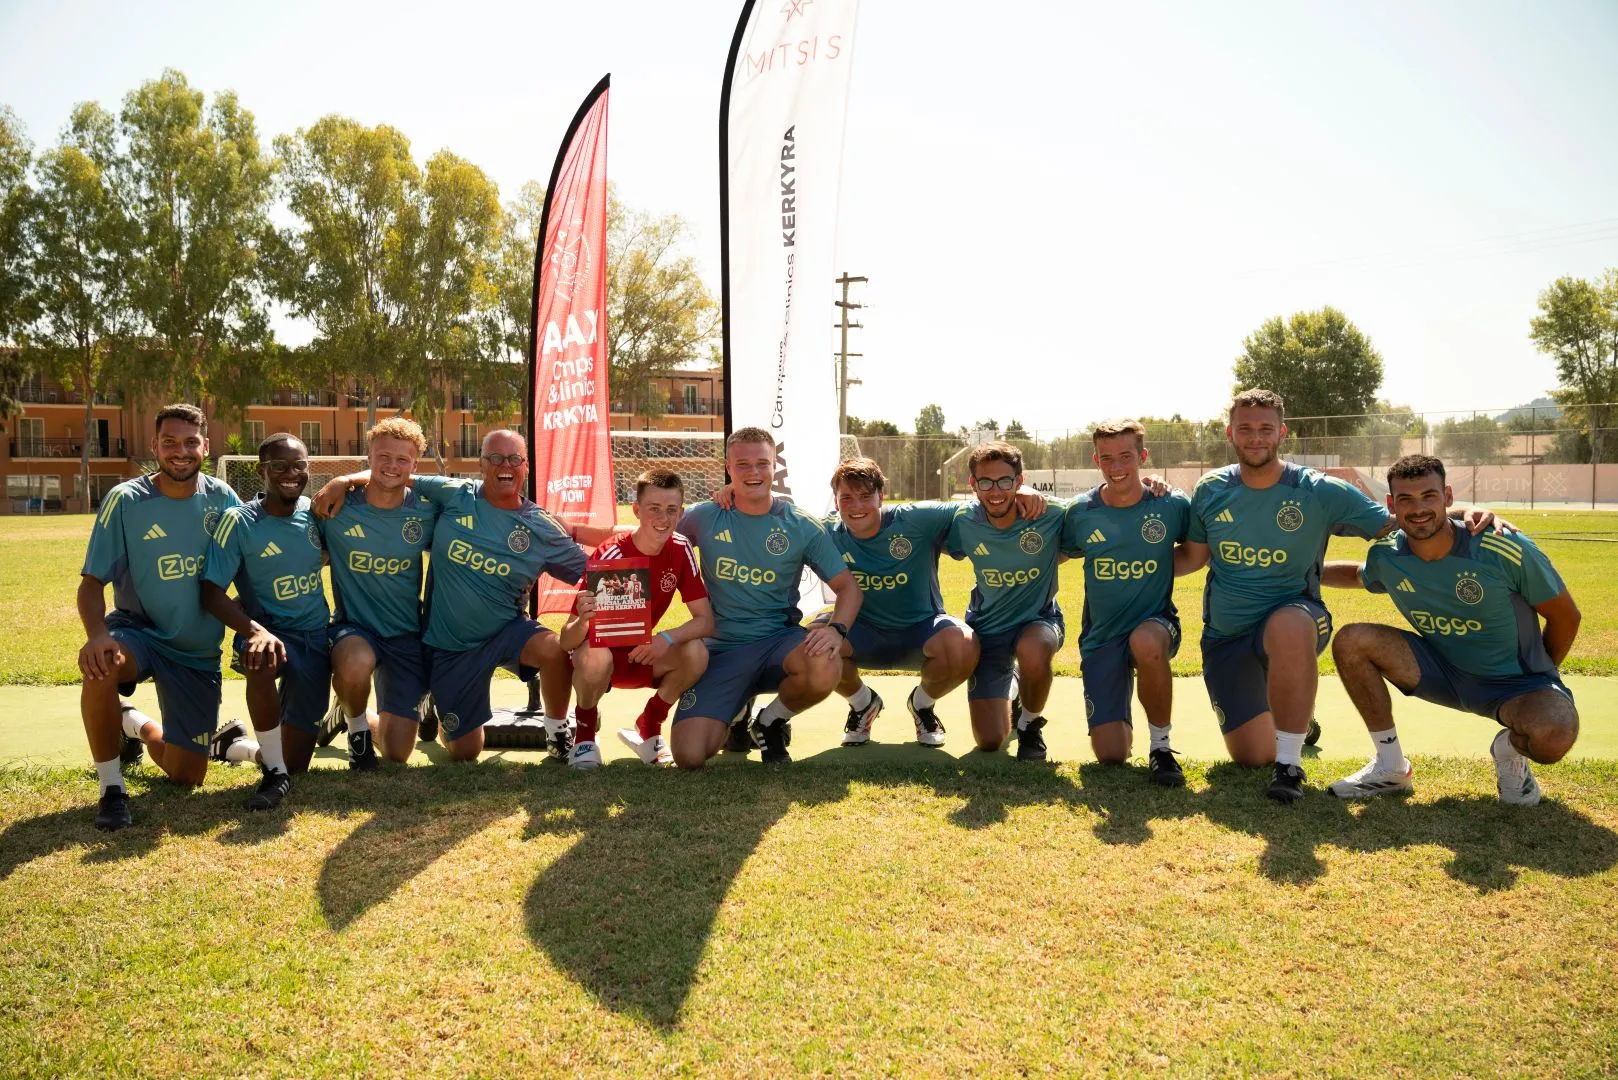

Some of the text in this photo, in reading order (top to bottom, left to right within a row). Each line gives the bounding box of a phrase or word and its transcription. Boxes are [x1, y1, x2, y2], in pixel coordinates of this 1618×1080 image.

[746, 35, 841, 77] MITSIS
[781, 125, 795, 247] KERKYRA
[542, 309, 598, 355] AAX
[1032, 482, 1054, 492] AJAX
[158, 553, 205, 580] Zigg
[349, 551, 411, 575] Ziggo
[448, 539, 511, 576] Ziggo
[1220, 541, 1287, 567] Ziggo
[716, 556, 776, 585] Ziggo
[982, 568, 1040, 588] Ziggo
[1094, 558, 1157, 580] Ziggo
[1411, 610, 1482, 635] Ziggo
[578, 744, 593, 752] NIKE
